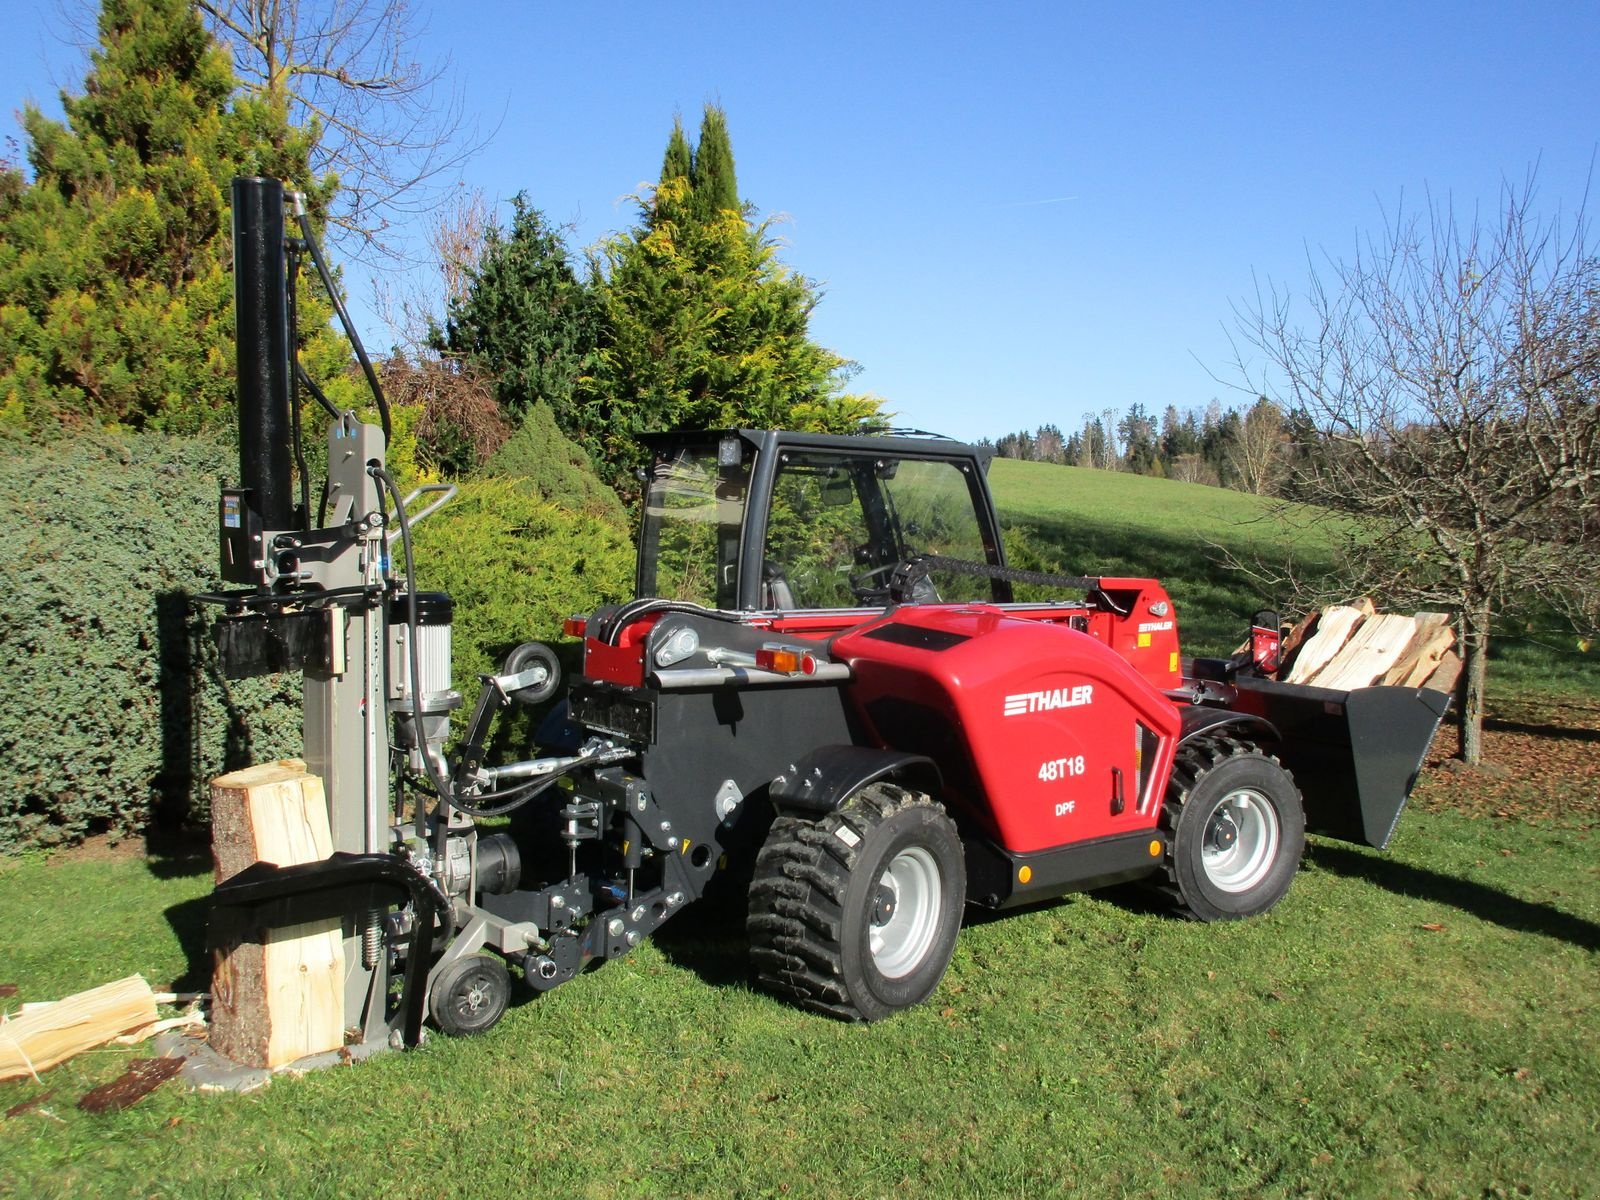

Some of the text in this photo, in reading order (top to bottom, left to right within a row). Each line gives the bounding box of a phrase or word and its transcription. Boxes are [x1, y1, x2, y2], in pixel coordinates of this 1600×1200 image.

[1026, 685, 1093, 713] THALER
[1038, 755, 1085, 782] 48T18
[1055, 800, 1075, 817] DPF
